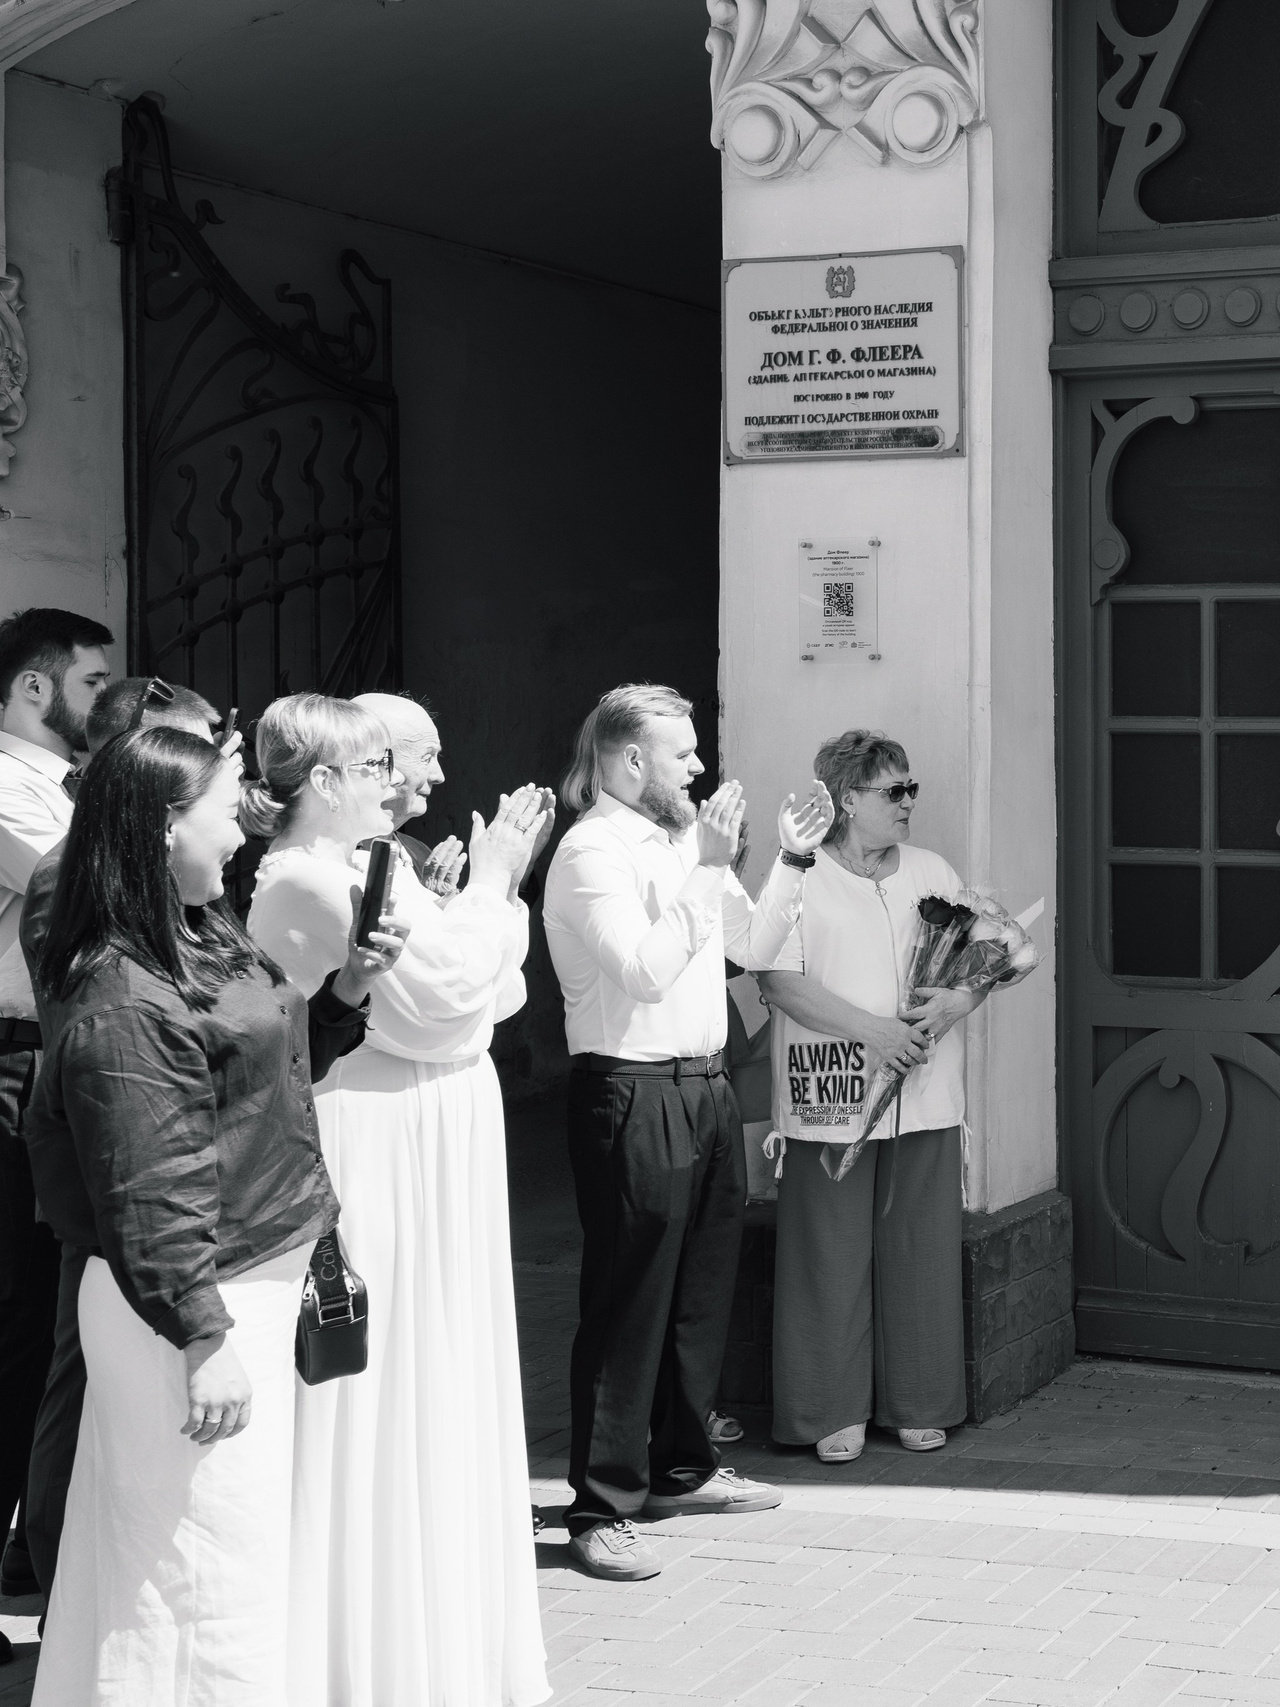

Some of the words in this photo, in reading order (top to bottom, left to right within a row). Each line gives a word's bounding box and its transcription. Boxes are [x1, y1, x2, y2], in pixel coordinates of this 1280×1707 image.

[874, 302, 934, 316] НАСЛЕДИЯ
[860, 316, 919, 331] ЗНАЧЕНИЯ
[760, 350, 804, 371] ДОМ
[808, 349, 822, 366] Г.
[826, 348, 847, 365] Ф.
[850, 344, 924, 363] ФЛЕЕРА
[747, 373, 790, 386] (ЗДАНИЕ
[877, 365, 937, 379] МАГАЗИНА)
[846, 392, 852, 401] В
[854, 391, 870, 400] 1900
[873, 390, 895, 401] ГОДУ
[744, 414, 800, 427] ПОДЛЕЖИТ
[788, 1041, 865, 1074] ALWAYS
[789, 1075, 812, 1105] BE
[816, 1073, 865, 1105] KIND
[834, 1115, 851, 1125] CARE
[316, 1233, 338, 1281] Calv
